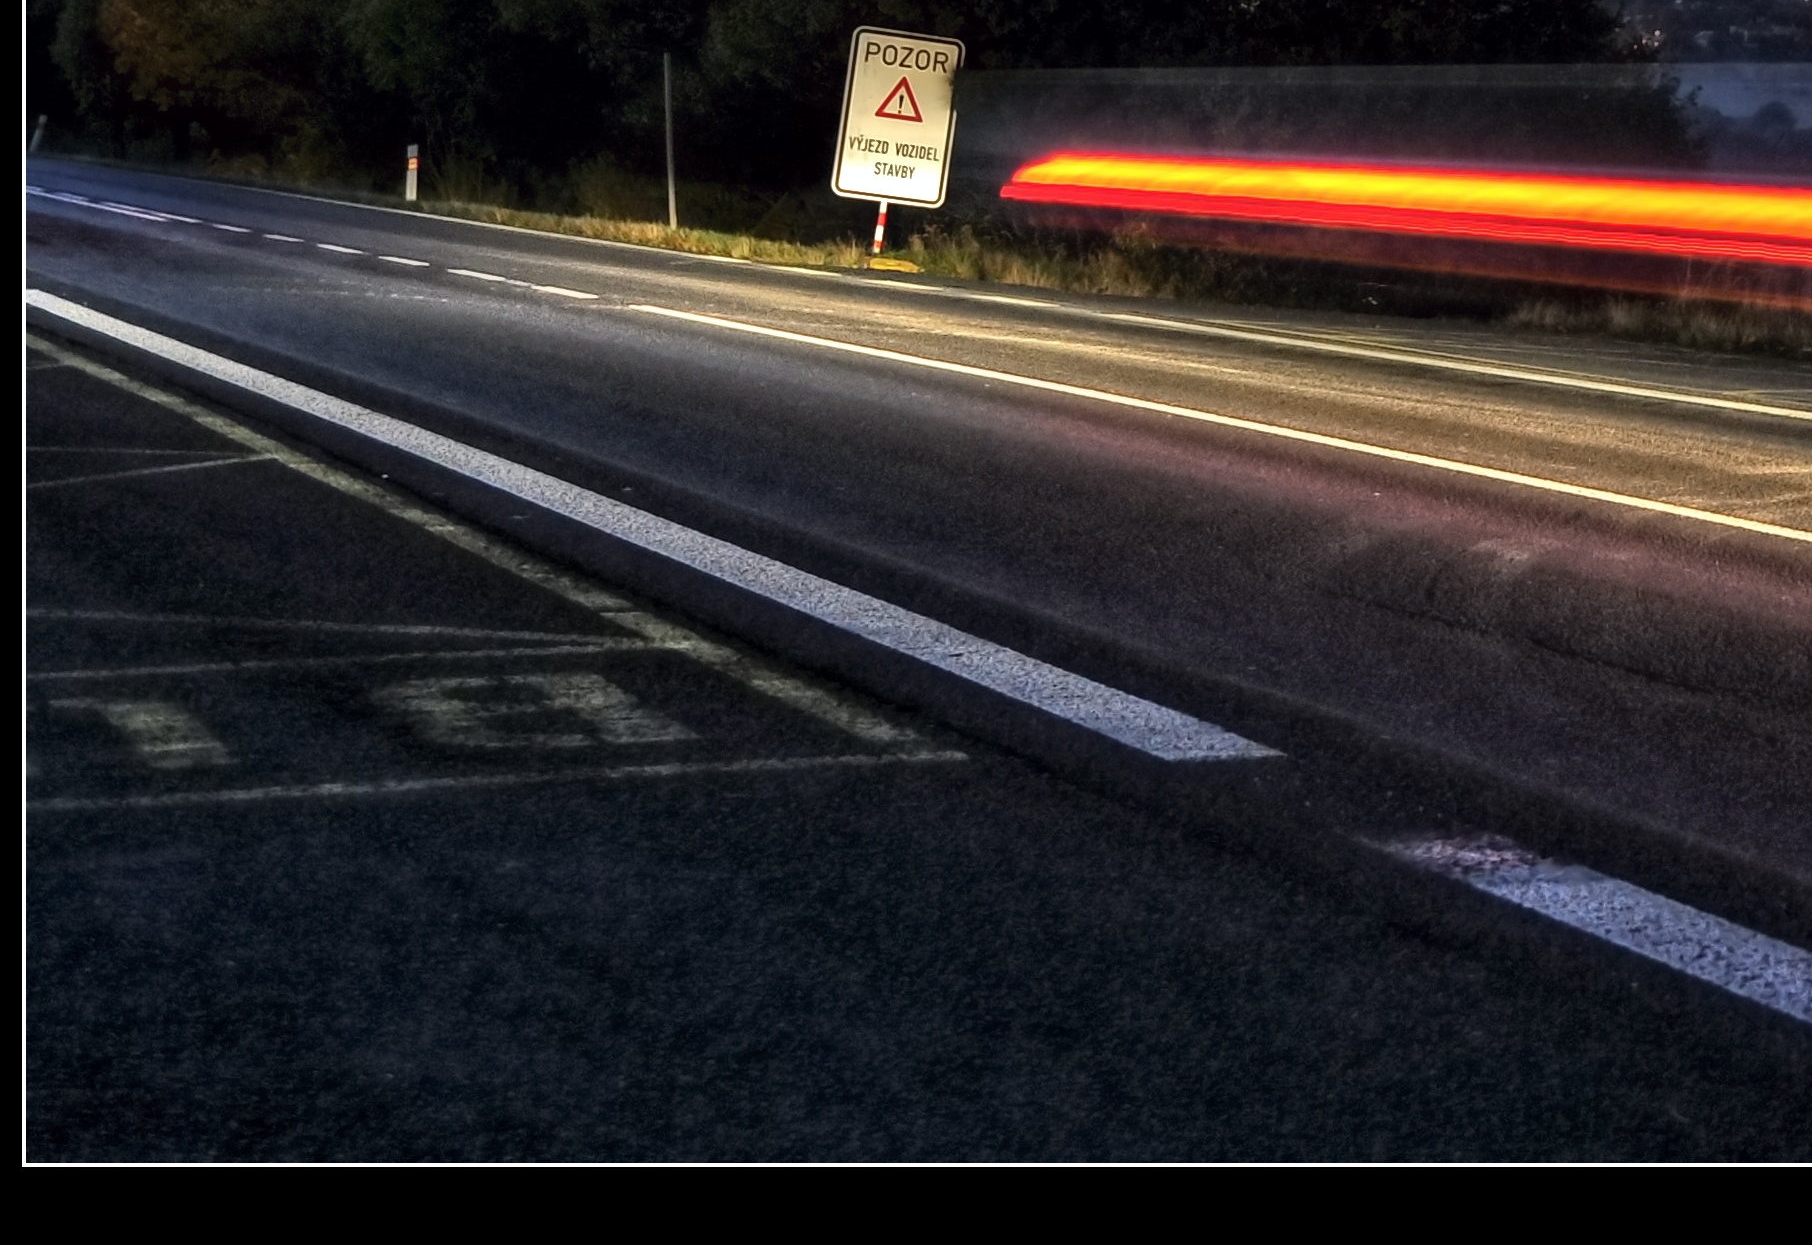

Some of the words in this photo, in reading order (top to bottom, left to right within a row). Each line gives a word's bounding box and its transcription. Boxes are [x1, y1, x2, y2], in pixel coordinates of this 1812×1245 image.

[864, 41, 949, 74] POZOR
[849, 134, 890, 155] VÝJEZD
[895, 142, 940, 162] VOZIDEL
[873, 161, 916, 180] STAVBY
